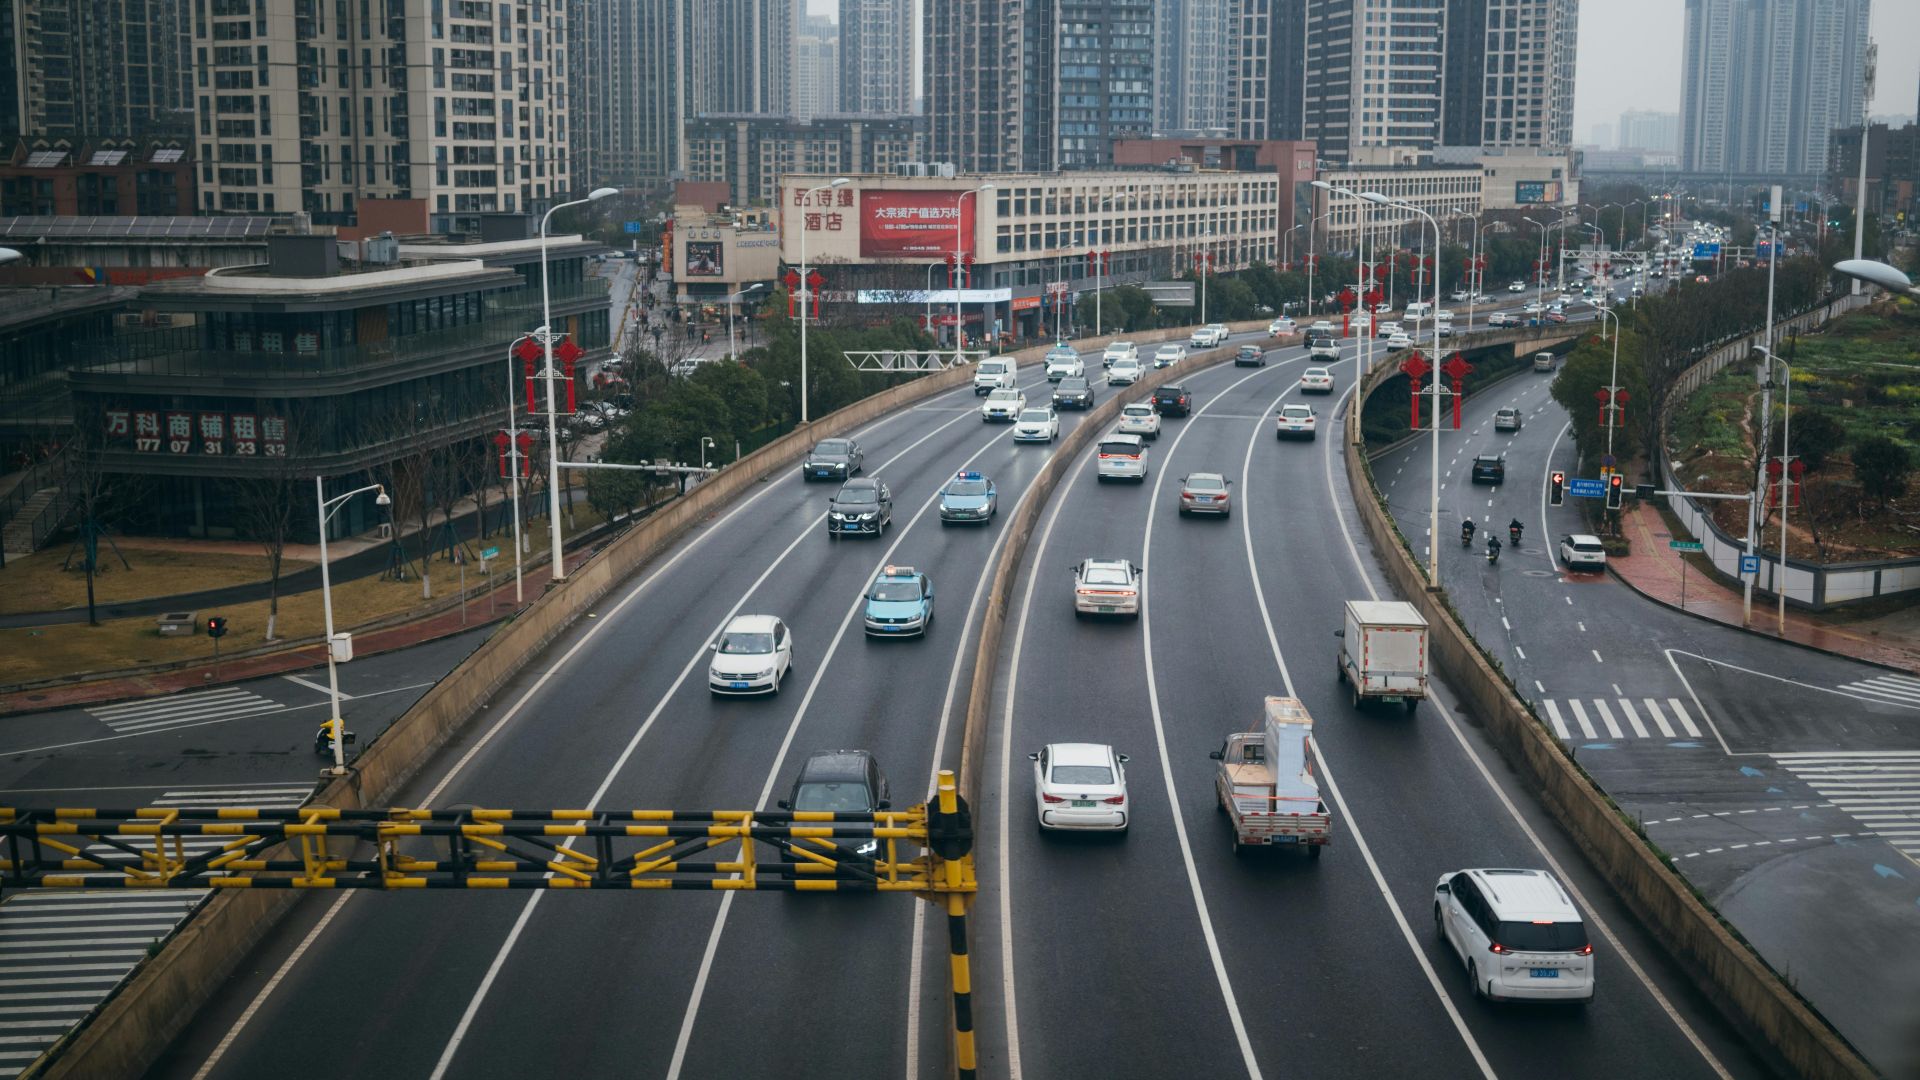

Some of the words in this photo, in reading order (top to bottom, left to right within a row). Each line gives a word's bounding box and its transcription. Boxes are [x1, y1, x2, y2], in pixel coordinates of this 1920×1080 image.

[804, 212, 843, 231] 酒店
[106, 411, 286, 441] 万科商铺租售
[136, 438, 161, 452] 177
[170, 440, 190, 454] 07
[205, 441, 222, 455] 31
